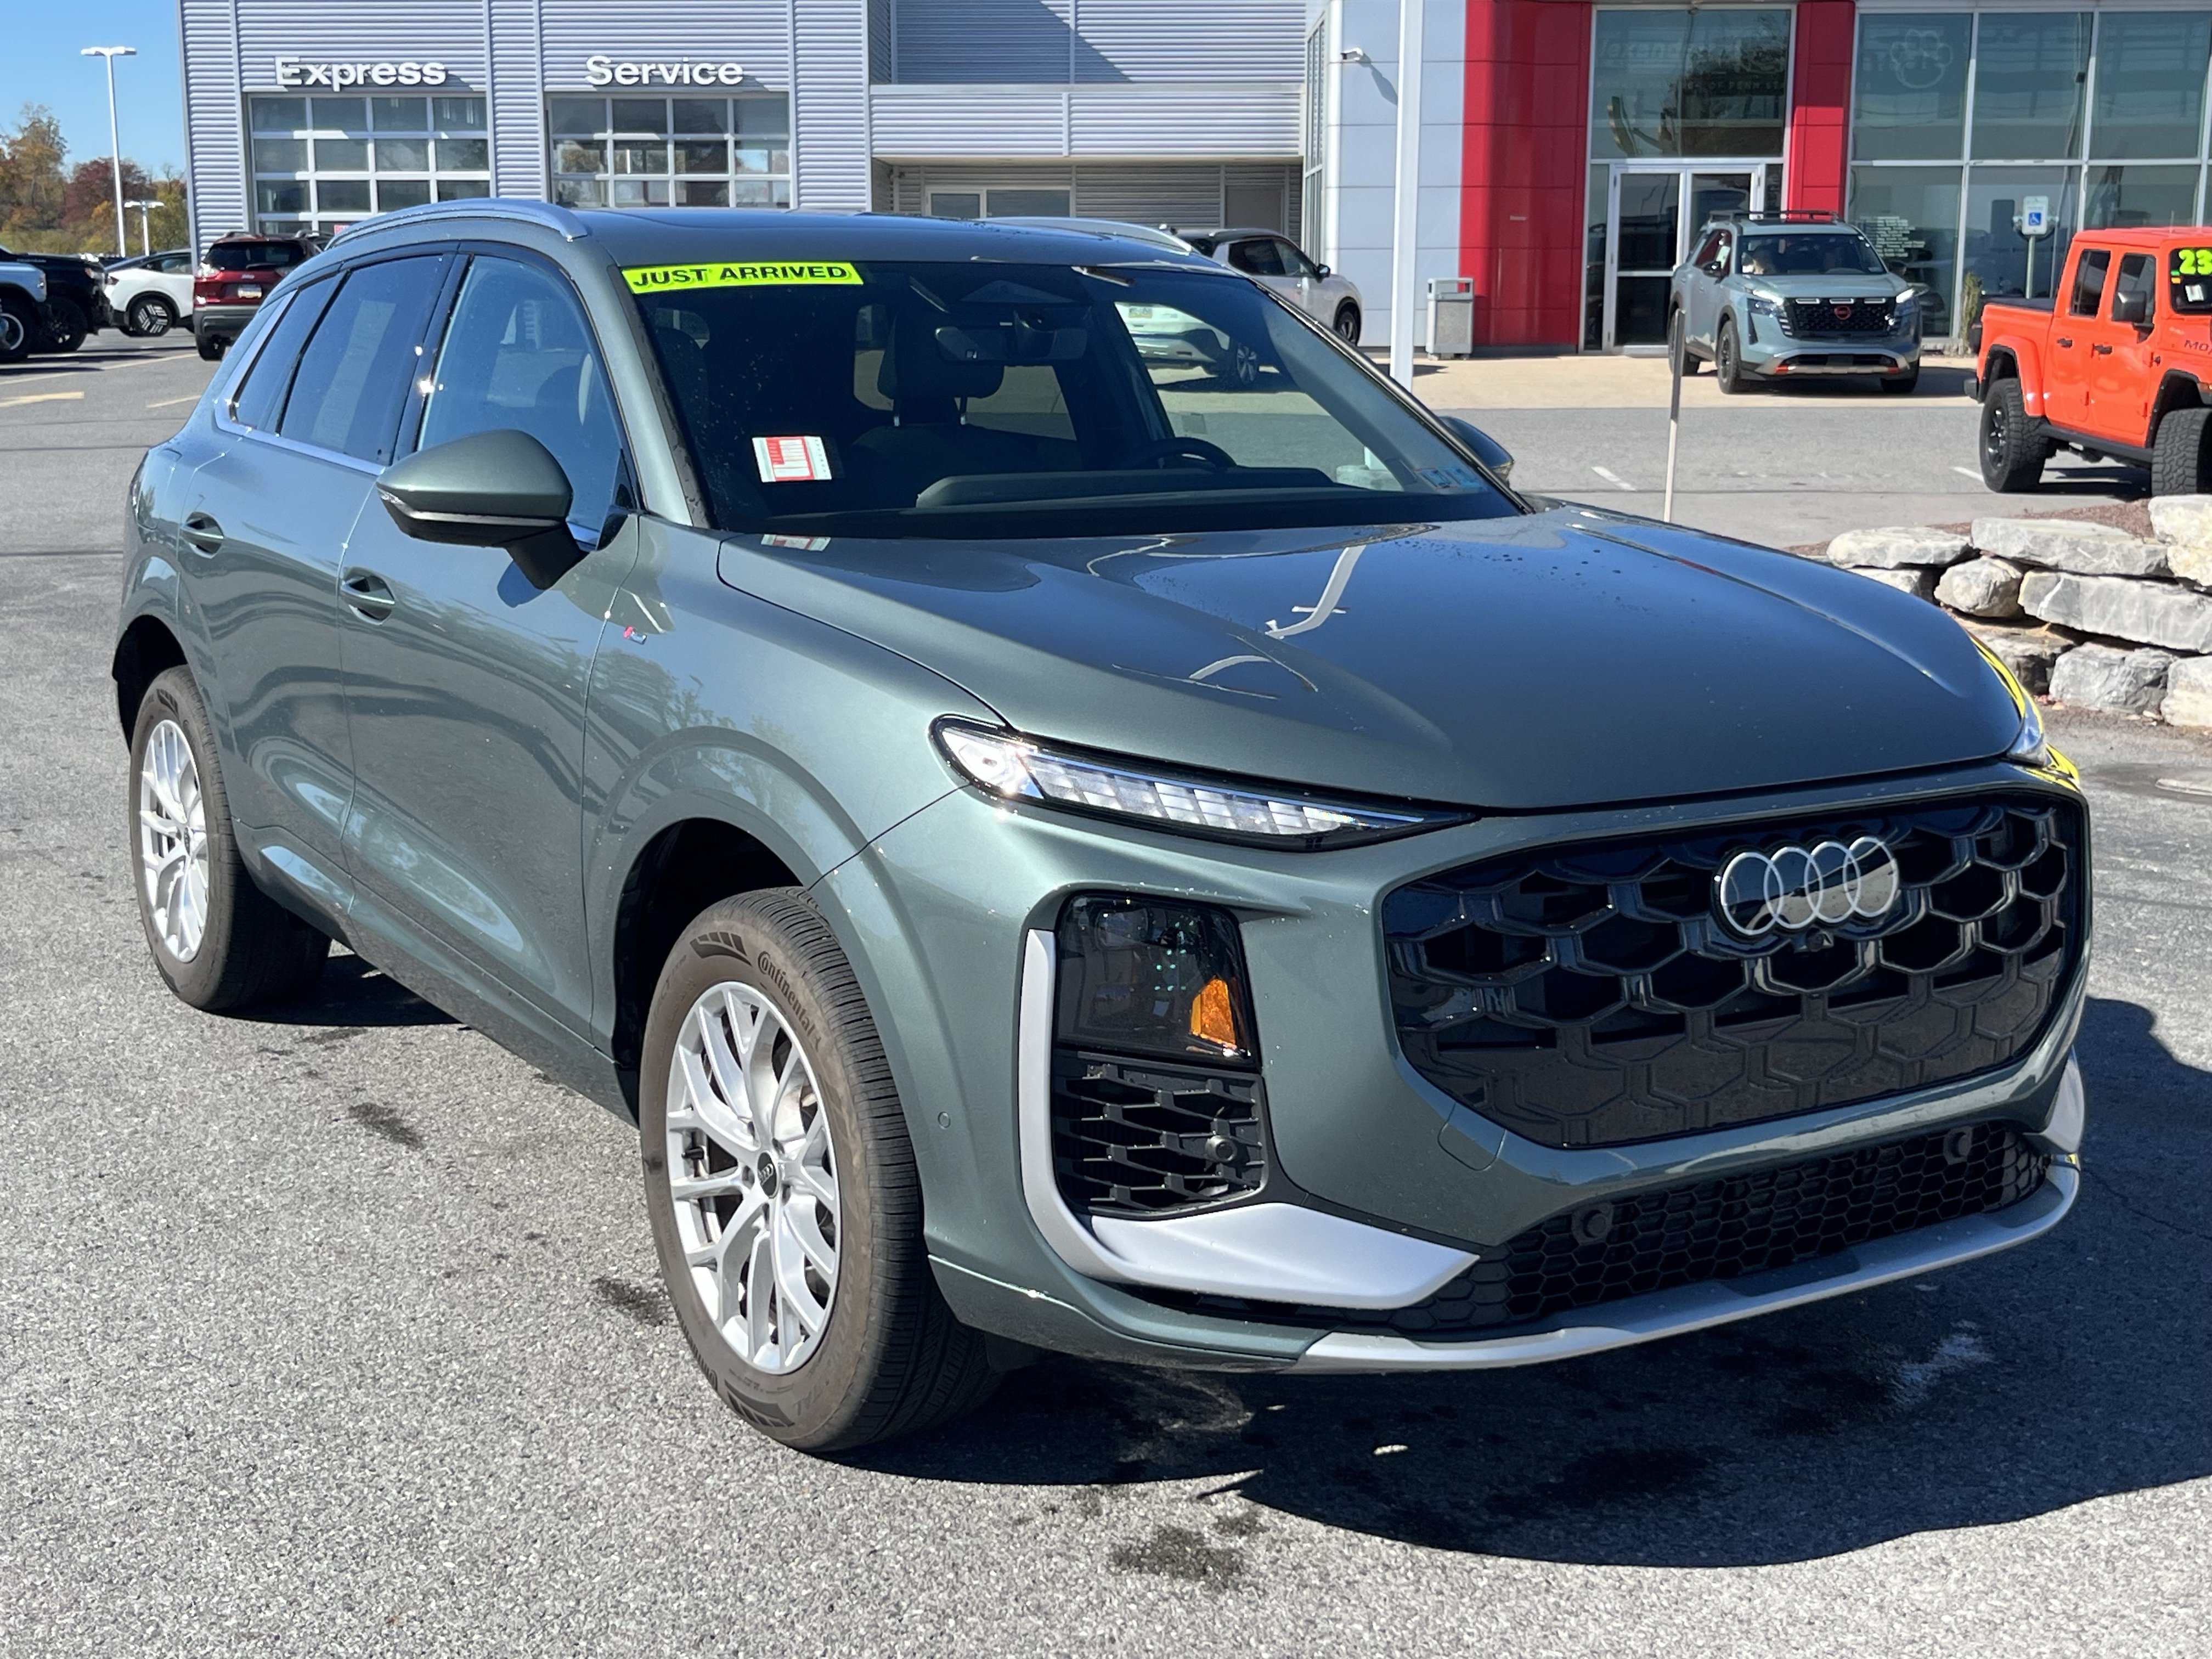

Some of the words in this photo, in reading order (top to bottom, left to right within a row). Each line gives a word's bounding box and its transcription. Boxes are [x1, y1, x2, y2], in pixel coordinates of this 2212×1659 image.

[275, 57, 446, 92] Express
[585, 55, 743, 85] Service
[633, 269, 707, 286] JUST
[719, 266, 847, 280] ARRIVED
[2178, 249, 2212, 275] 23
[757, 951, 816, 1036] Continental
